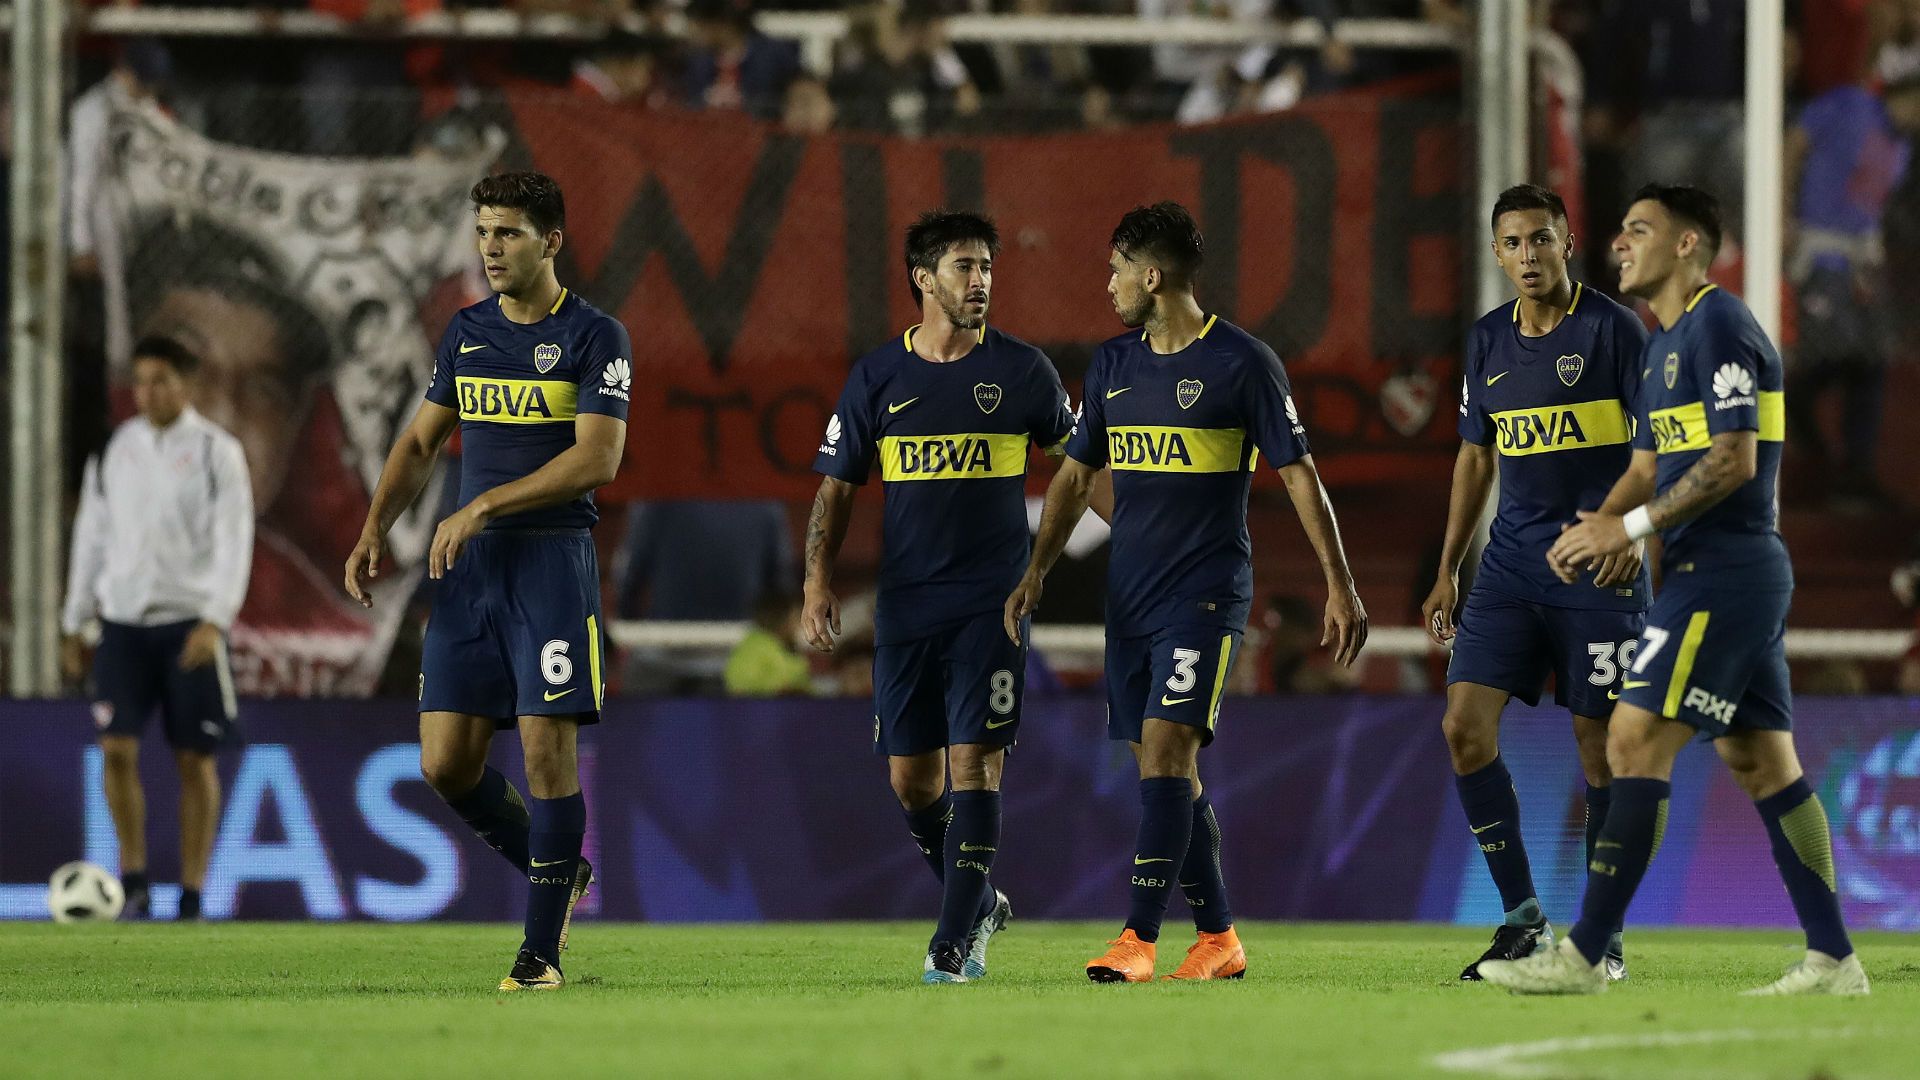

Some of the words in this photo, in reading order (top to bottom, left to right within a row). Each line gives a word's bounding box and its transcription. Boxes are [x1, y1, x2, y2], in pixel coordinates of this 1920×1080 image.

[460, 382, 553, 418] BBVA
[1110, 431, 1193, 466] BBVA
[1497, 410, 1587, 450] BBVA
[899, 438, 993, 474] BBVA
[540, 639, 573, 685] 6
[1587, 639, 1639, 686] 39
[1631, 625, 1670, 674] 7
[1166, 647, 1201, 693] 3
[989, 669, 1016, 715] 8
[1479, 840, 1506, 853] ABJ
[956, 859, 991, 875] CABJ
[1131, 875, 1166, 888] CABJ
